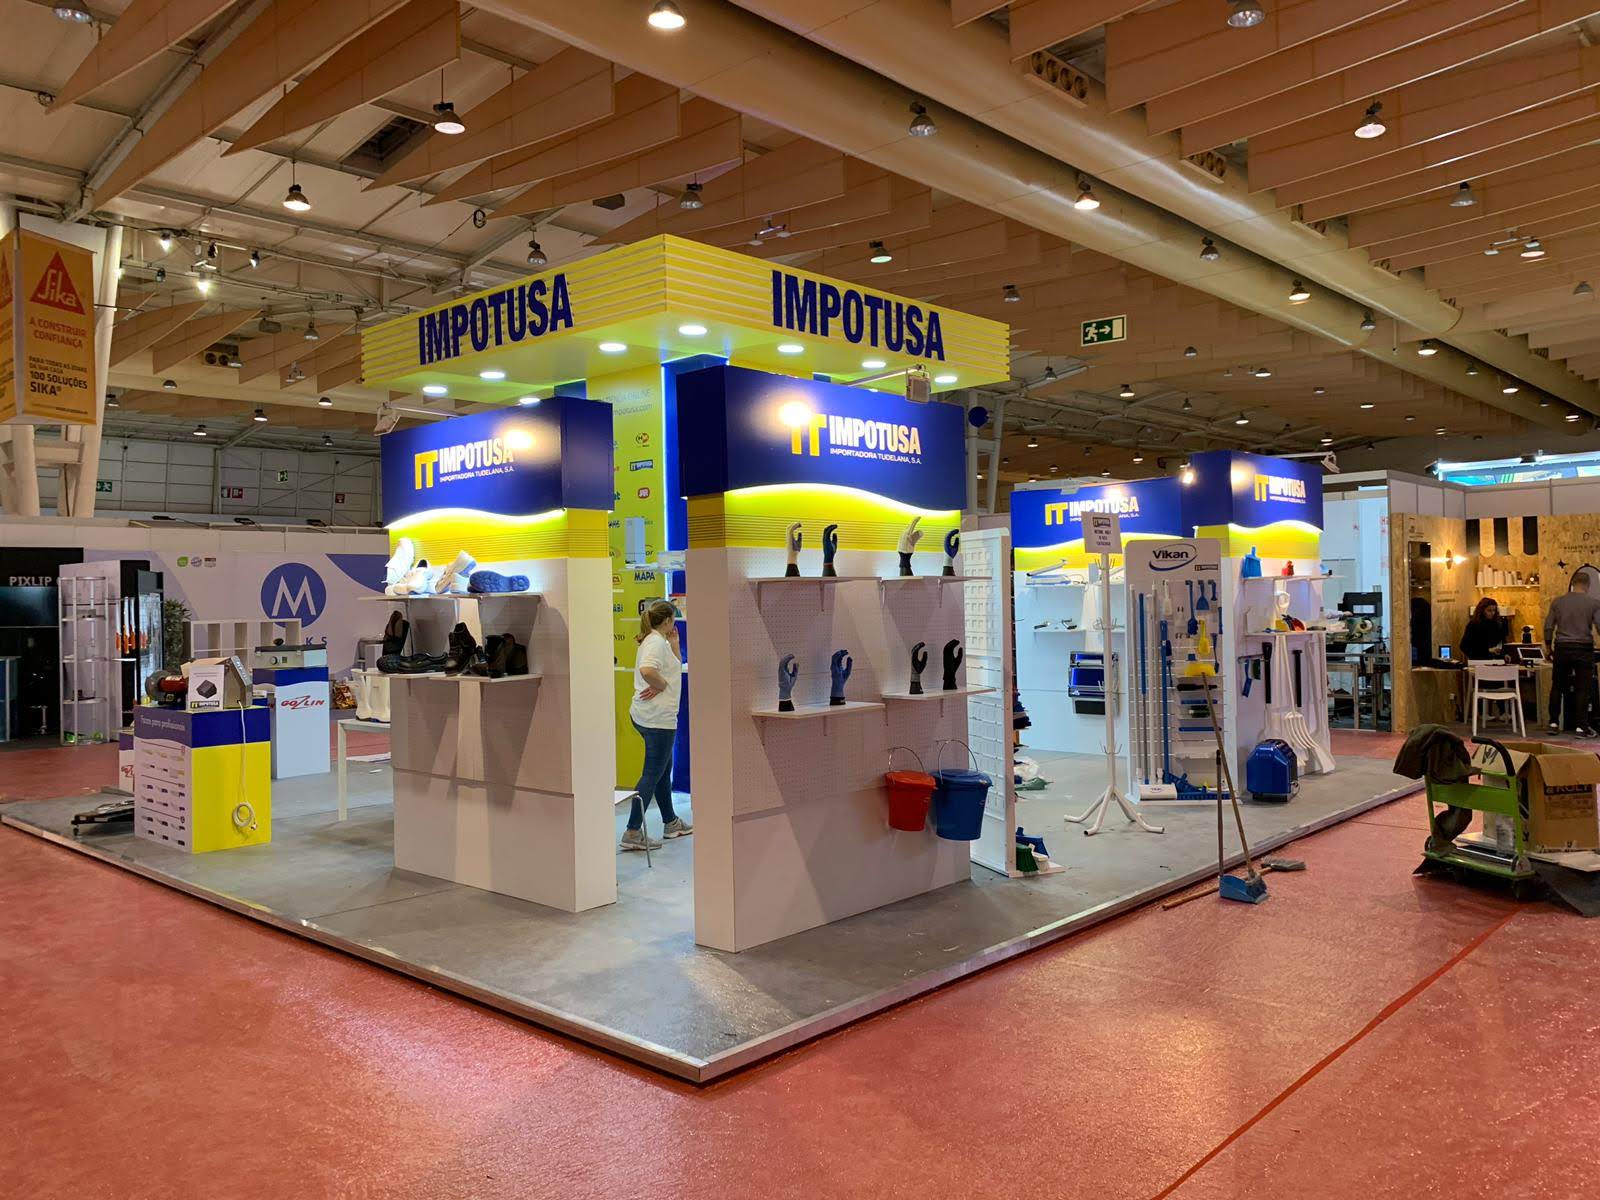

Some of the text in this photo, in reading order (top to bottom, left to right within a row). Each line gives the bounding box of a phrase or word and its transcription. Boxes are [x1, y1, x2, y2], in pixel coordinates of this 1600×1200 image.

[38, 269, 77, 307] Sika
[418, 272, 574, 365] IMPOTUSA
[772, 269, 946, 361] IMPOTUSA
[38, 319, 87, 337] CONSTRUIR
[33, 329, 83, 349] CONFIANÇA
[29, 370, 46, 381] 100
[47, 373, 88, 389] SOLUÇÕES
[828, 414, 921, 455] IMPOTUSA
[439, 438, 514, 475] IMPOTUSA
[830, 448, 878, 460] IMPORTADORA
[1269, 475, 1306, 498] IMPOTUSA
[1069, 496, 1140, 517] IMPOTUSA
[1152, 550, 1189, 559] Vikan
[9, 576, 52, 587] PIXLIP
[633, 571, 656, 581] MAPA
[271, 575, 316, 617] M
[281, 695, 325, 710] GOZLIN
